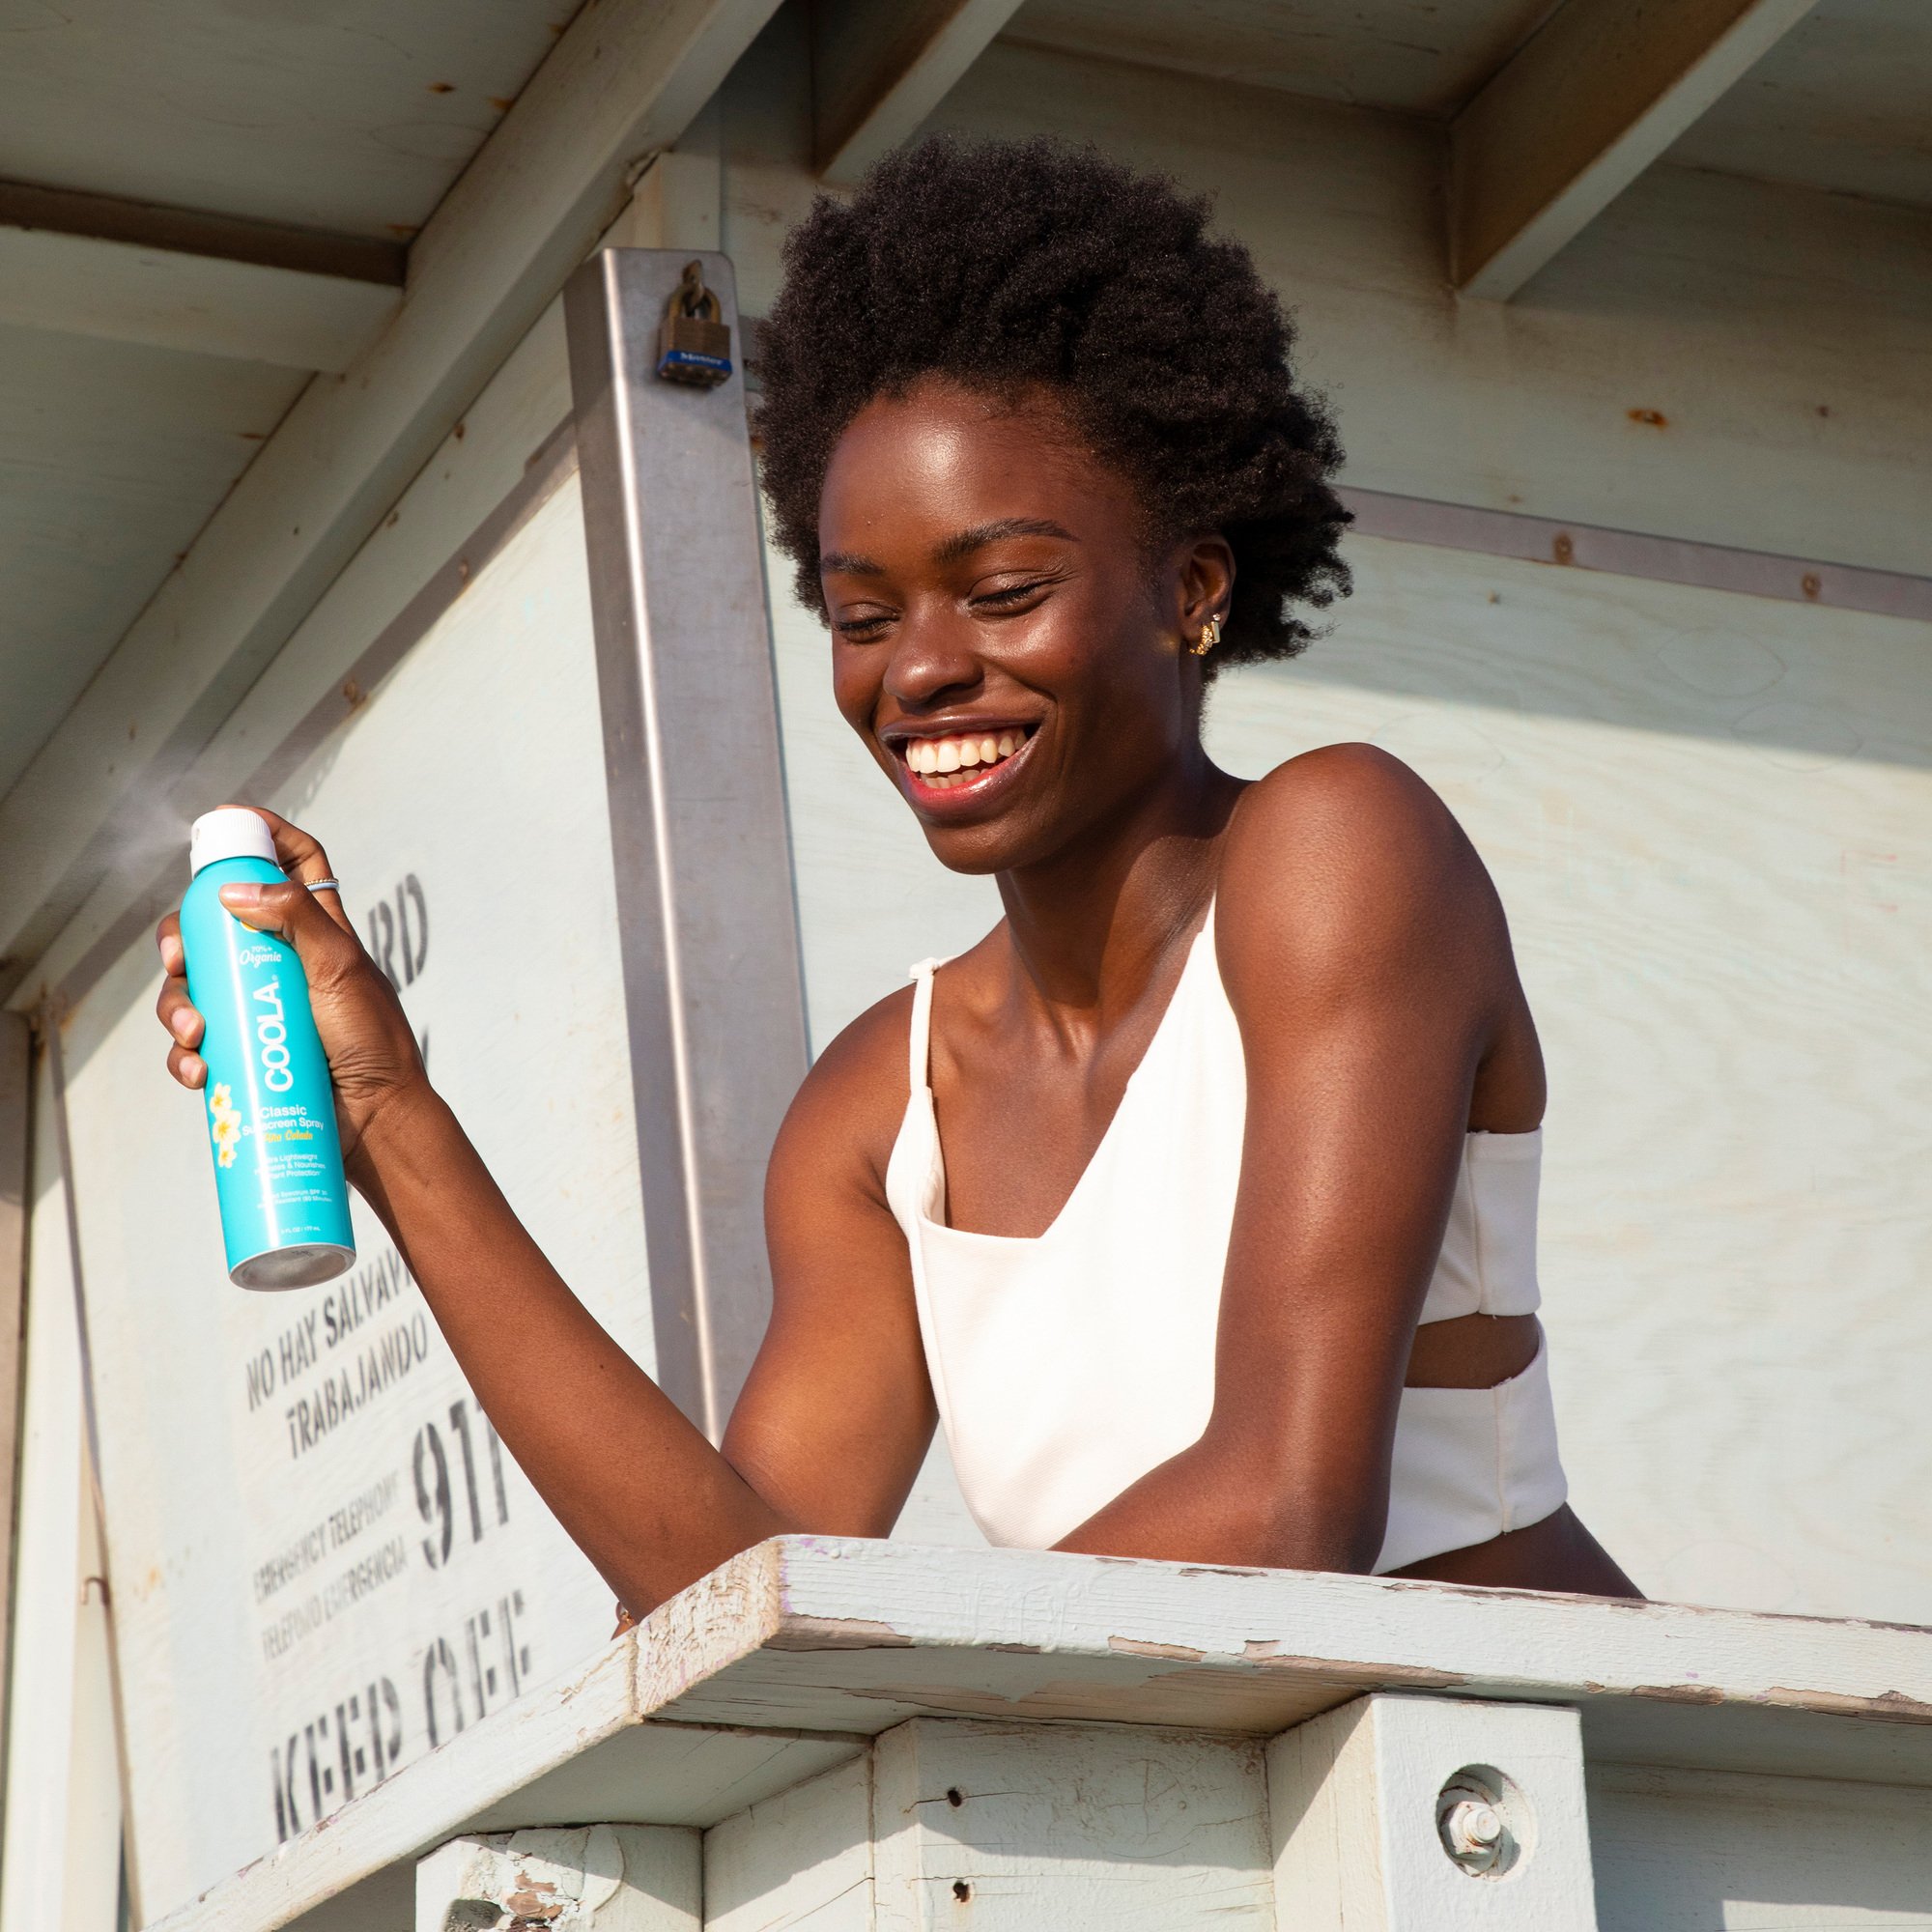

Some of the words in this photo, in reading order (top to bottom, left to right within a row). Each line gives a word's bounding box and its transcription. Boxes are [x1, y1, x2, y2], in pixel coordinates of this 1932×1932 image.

[240, 950, 282, 968] Organic
[253, 981, 294, 1093] COOLA
[260, 1104, 306, 1119] Classic
[298, 1117, 324, 1130] Spray
[246, 1349, 274, 1412] NO
[279, 1308, 316, 1385] HAY
[287, 1310, 427, 1459] TRABAJANDO
[412, 1398, 508, 1572] 911
[270, 1674, 402, 1843] KEEP
[424, 1589, 530, 1749] OFF
